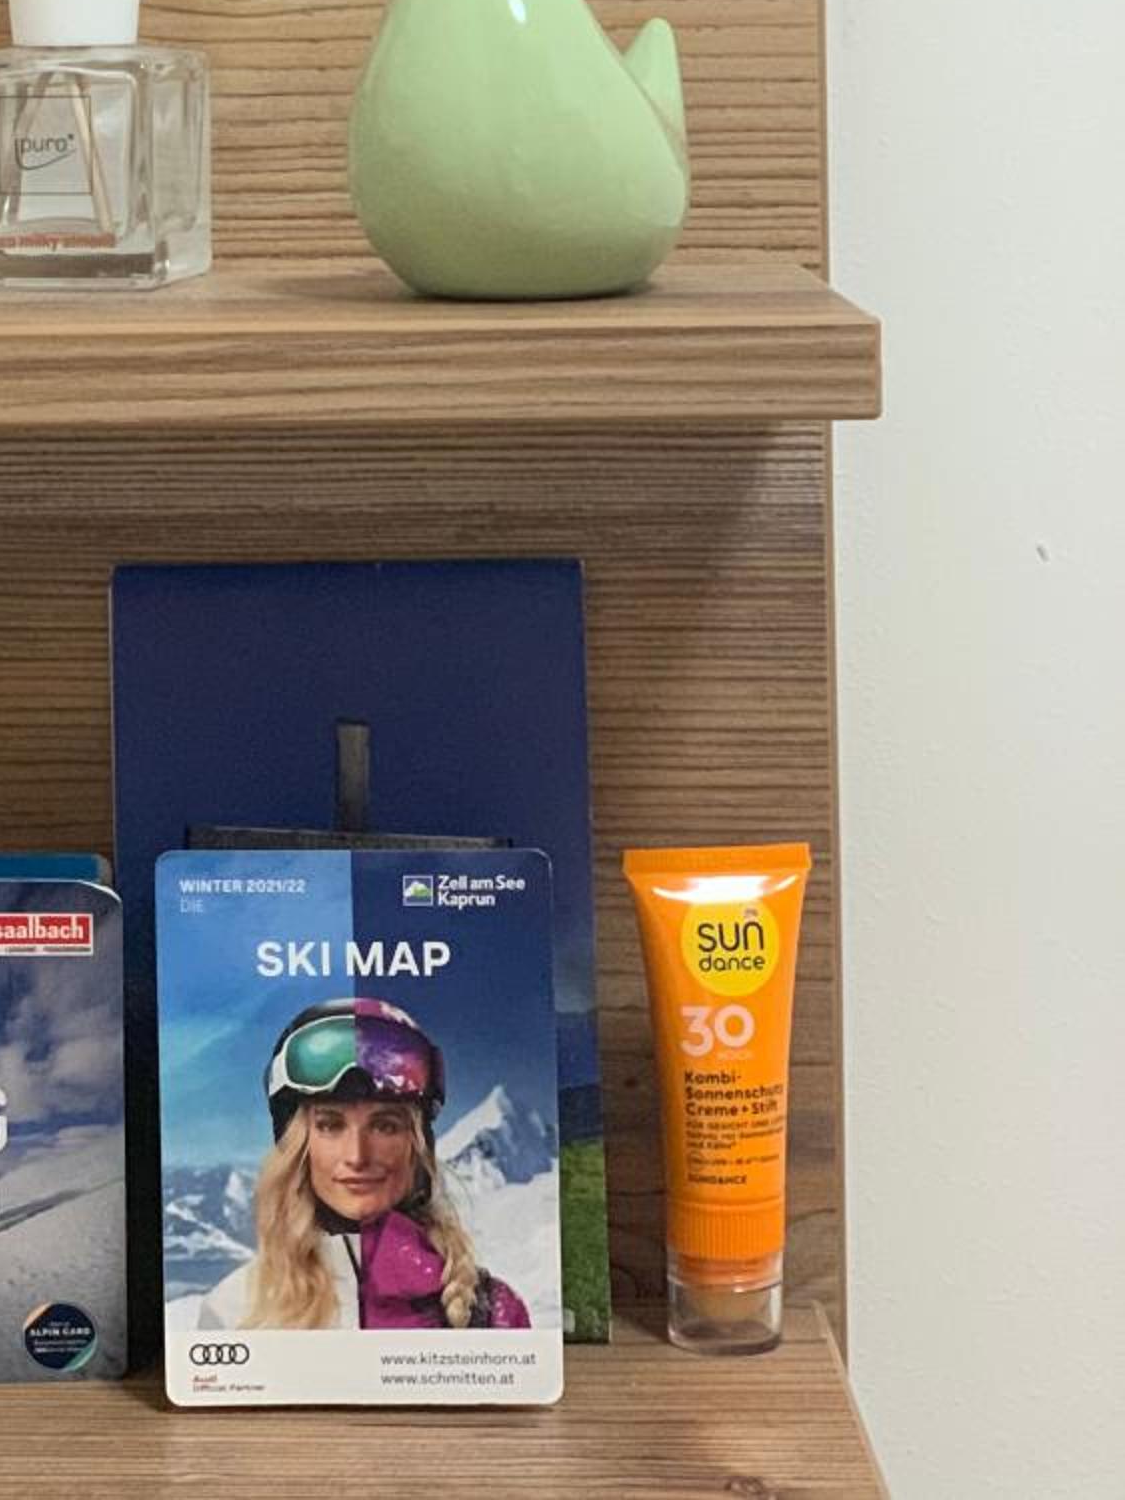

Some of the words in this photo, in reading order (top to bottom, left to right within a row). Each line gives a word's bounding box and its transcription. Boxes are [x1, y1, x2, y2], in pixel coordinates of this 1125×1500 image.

[179, 879, 244, 894] WINTER
[246, 878, 306, 894] 2021/22
[438, 875, 467, 891] Zell
[469, 879, 493, 891] am
[495, 875, 526, 891] See
[180, 900, 203, 913] DIE
[438, 892, 496, 910] Kaprun
[698, 921, 764, 952] sun
[256, 941, 331, 977] SKI
[346, 941, 451, 977] MAP
[699, 955, 766, 972] dance
[680, 1003, 756, 1058] 30
[684, 1071, 742, 1084] Kombi-
[686, 1102, 738, 1116] Creme
[381, 1350, 536, 1366] www.kitzsteinhorn.at
[381, 1371, 515, 1386] www.schmitten.at
